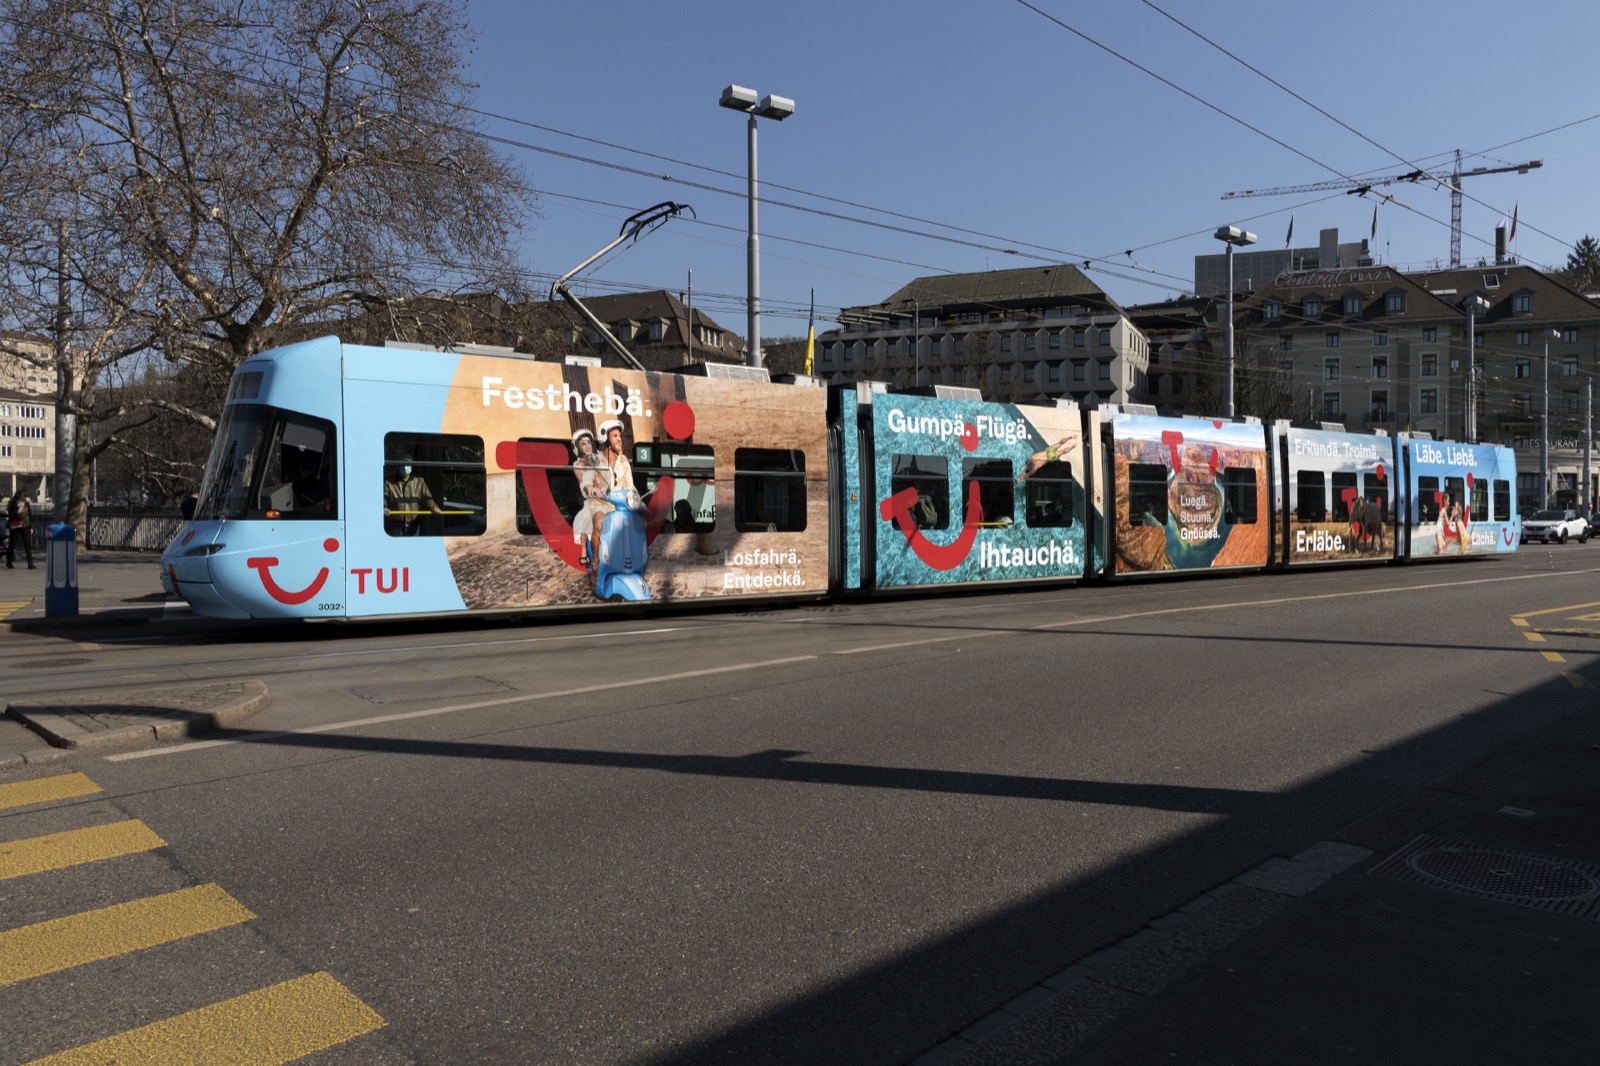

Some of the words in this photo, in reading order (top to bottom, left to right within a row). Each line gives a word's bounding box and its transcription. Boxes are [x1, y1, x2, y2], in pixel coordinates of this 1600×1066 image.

[1275, 269, 1349, 287] Central
[482, 376, 652, 417] Festhebä.
[888, 409, 971, 441] Gumpä.
[976, 415, 1032, 445] Flügä.
[1294, 438, 1341, 457] Erkundä.
[1343, 442, 1380, 460] Troimä.
[1523, 439, 1579, 449] RESAURANT
[640, 449, 648, 460] 3
[1415, 443, 1445, 465] Läbe.
[1447, 446, 1478, 468] Liebä.
[1180, 494, 1208, 510] Luegä.
[1180, 510, 1214, 523] Stuunä.
[1180, 526, 1221, 540] Gnüüssä.
[1296, 529, 1346, 552] Erläbe.
[1471, 530, 1496, 546] Lachä.
[723, 548, 802, 566] Losfahrä.
[980, 539, 1080, 568] Ihtauchä.
[350, 567, 409, 594] TUI
[723, 570, 806, 589] Entdeckä.
[318, 603, 341, 611] 3032
